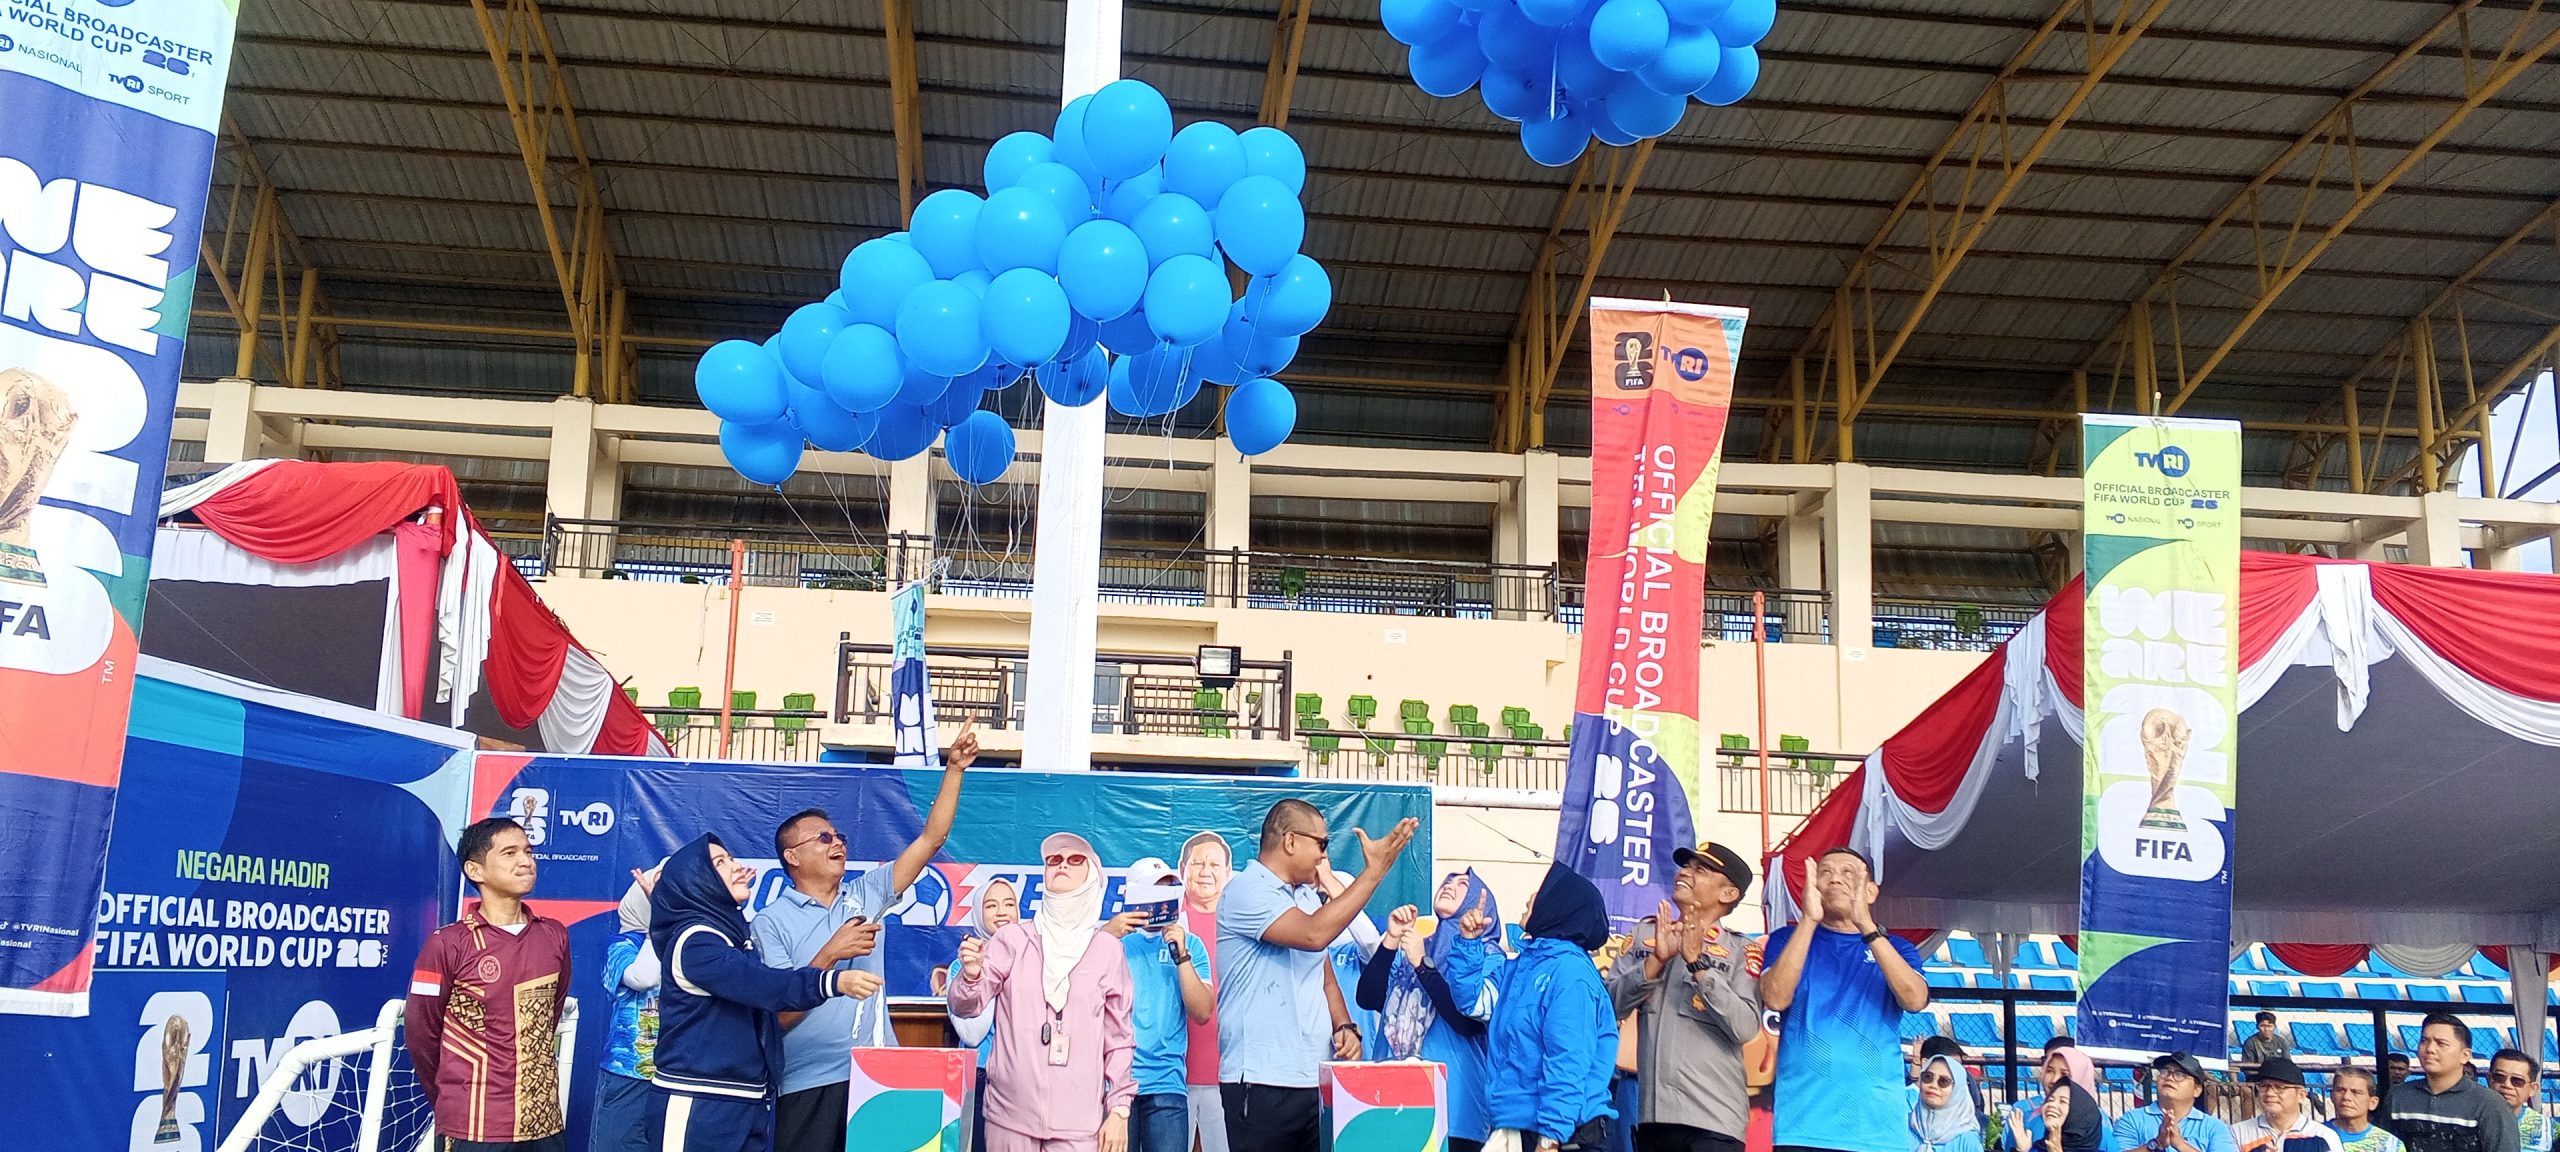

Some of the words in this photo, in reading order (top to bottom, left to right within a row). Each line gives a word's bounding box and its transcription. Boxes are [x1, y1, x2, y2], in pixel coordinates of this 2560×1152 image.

[9, 6, 84, 42] WORLD
[91, 35, 132, 55] CUP
[143, 50, 190, 76] 26
[64, 7, 213, 66] BROADCASTER
[19, 43, 83, 73] NASIONAL
[109, 74, 143, 91] TVRI
[147, 85, 190, 105] SPORT
[0, 248, 165, 356] RE
[1625, 378, 1644, 387] FIFA
[2135, 449, 2187, 474] TVRI
[2093, 482, 2145, 494] OFFICIAL
[2148, 486, 2230, 499] BROADCASTER
[2093, 493, 2117, 503] FIFA
[2120, 495, 2160, 506] WORLD
[2164, 497, 2184, 507] CUP
[2191, 499, 2218, 510] 26
[1643, 444, 1676, 600] OFFICIAL
[2100, 585, 2227, 646] WE
[102, 659, 116, 685] TM
[1621, 611, 1668, 886] BROADCASTER
[1589, 753, 1623, 845] 26
[560, 806, 612, 830] TVRI
[552, 854, 599, 862] BROADCASTER
[2135, 838, 2193, 862] FIFA
[176, 849, 265, 885] NEGARA
[270, 858, 330, 890] HADIR
[2221, 870, 2228, 885] TM
[98, 892, 219, 928] OFFICIAL
[225, 900, 390, 935] BROADCASTER
[12, 923, 79, 937] @TVRINasional
[94, 930, 160, 967] FIFA
[167, 933, 275, 968] WORLD
[280, 936, 333, 968] CUP
[336, 939, 383, 968] 26
[381, 945, 389, 968] TM
